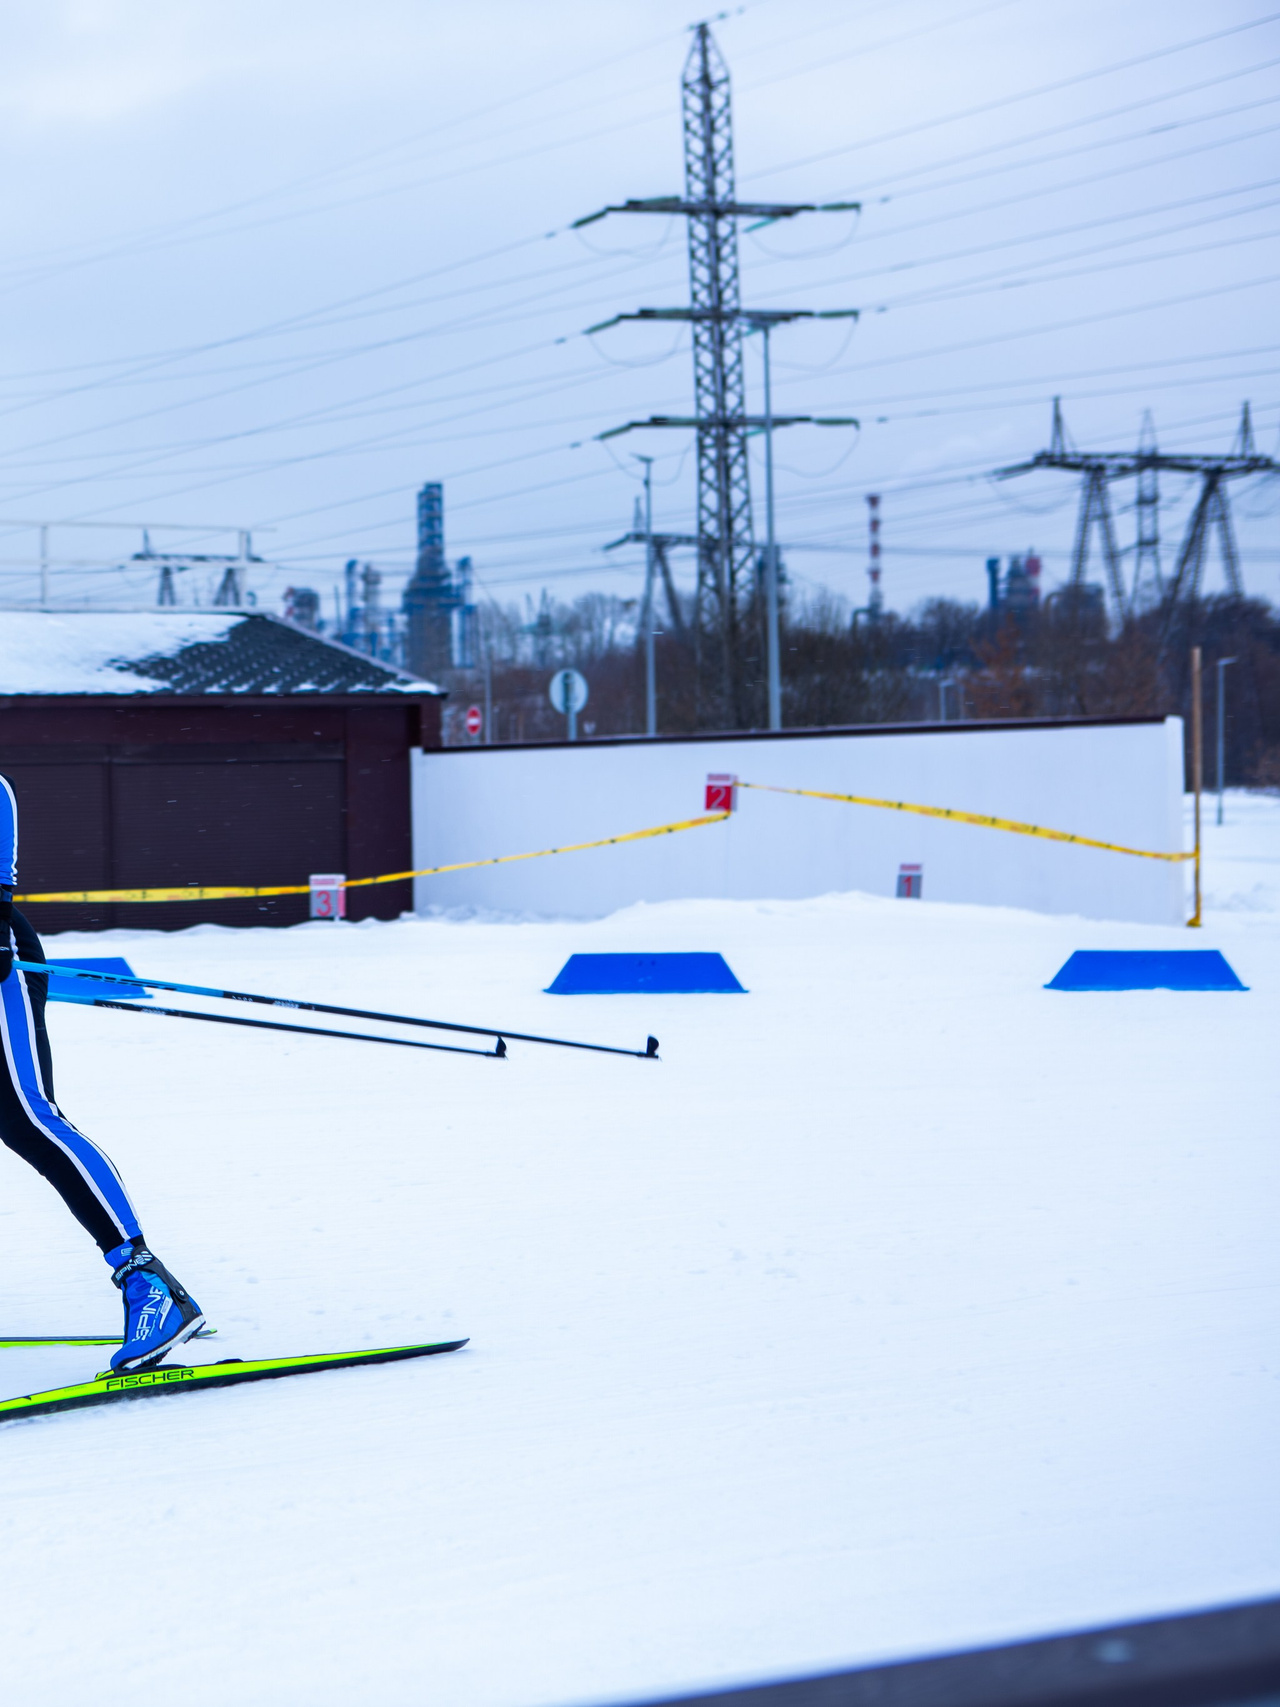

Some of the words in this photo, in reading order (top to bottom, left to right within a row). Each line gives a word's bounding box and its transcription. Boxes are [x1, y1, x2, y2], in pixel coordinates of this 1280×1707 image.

[710, 786, 727, 811] 2
[316, 890, 332, 917] 3
[131, 1285, 163, 1342] SPINE
[106, 1369, 195, 1391] FISCHER
